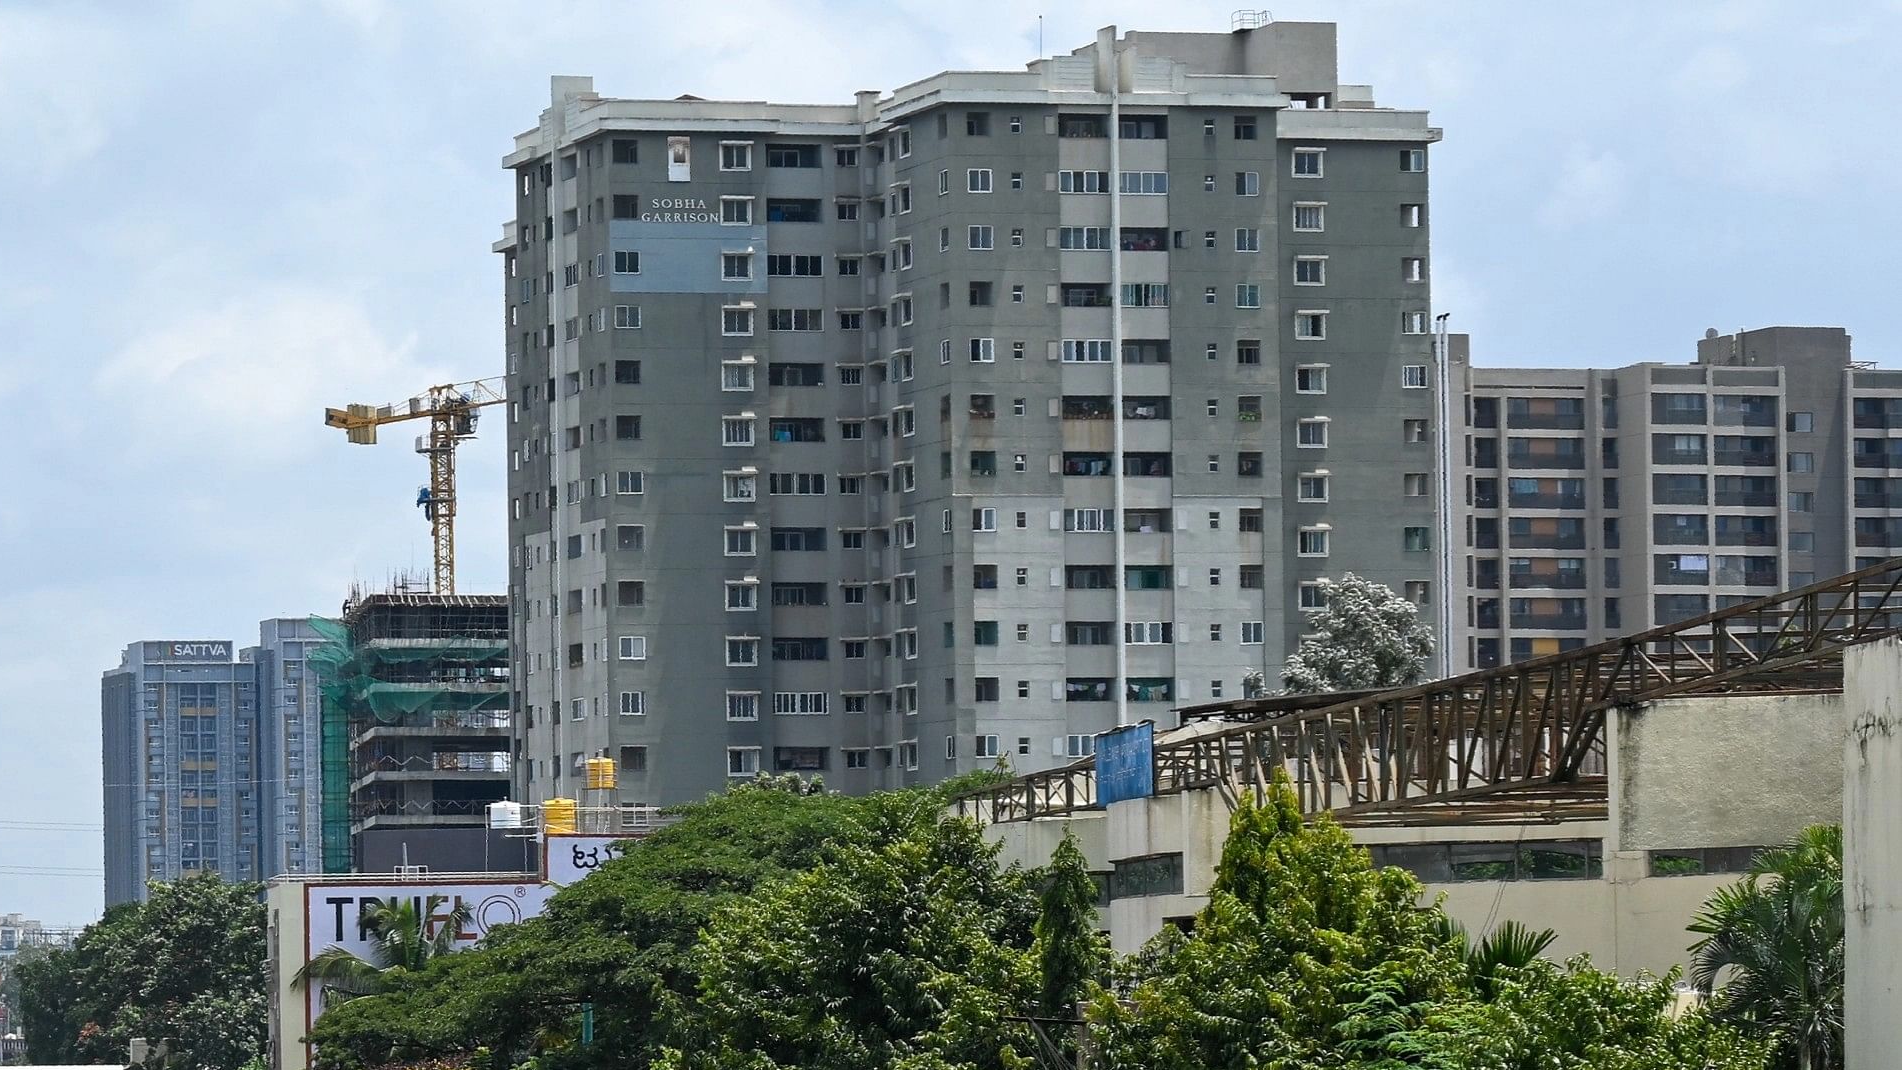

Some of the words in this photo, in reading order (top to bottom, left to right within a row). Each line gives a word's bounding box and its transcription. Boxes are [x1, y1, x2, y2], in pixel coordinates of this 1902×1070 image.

[652, 198, 706, 209] SOBHA
[641, 211, 719, 223] GARRISON
[174, 644, 226, 656] SATTVA
